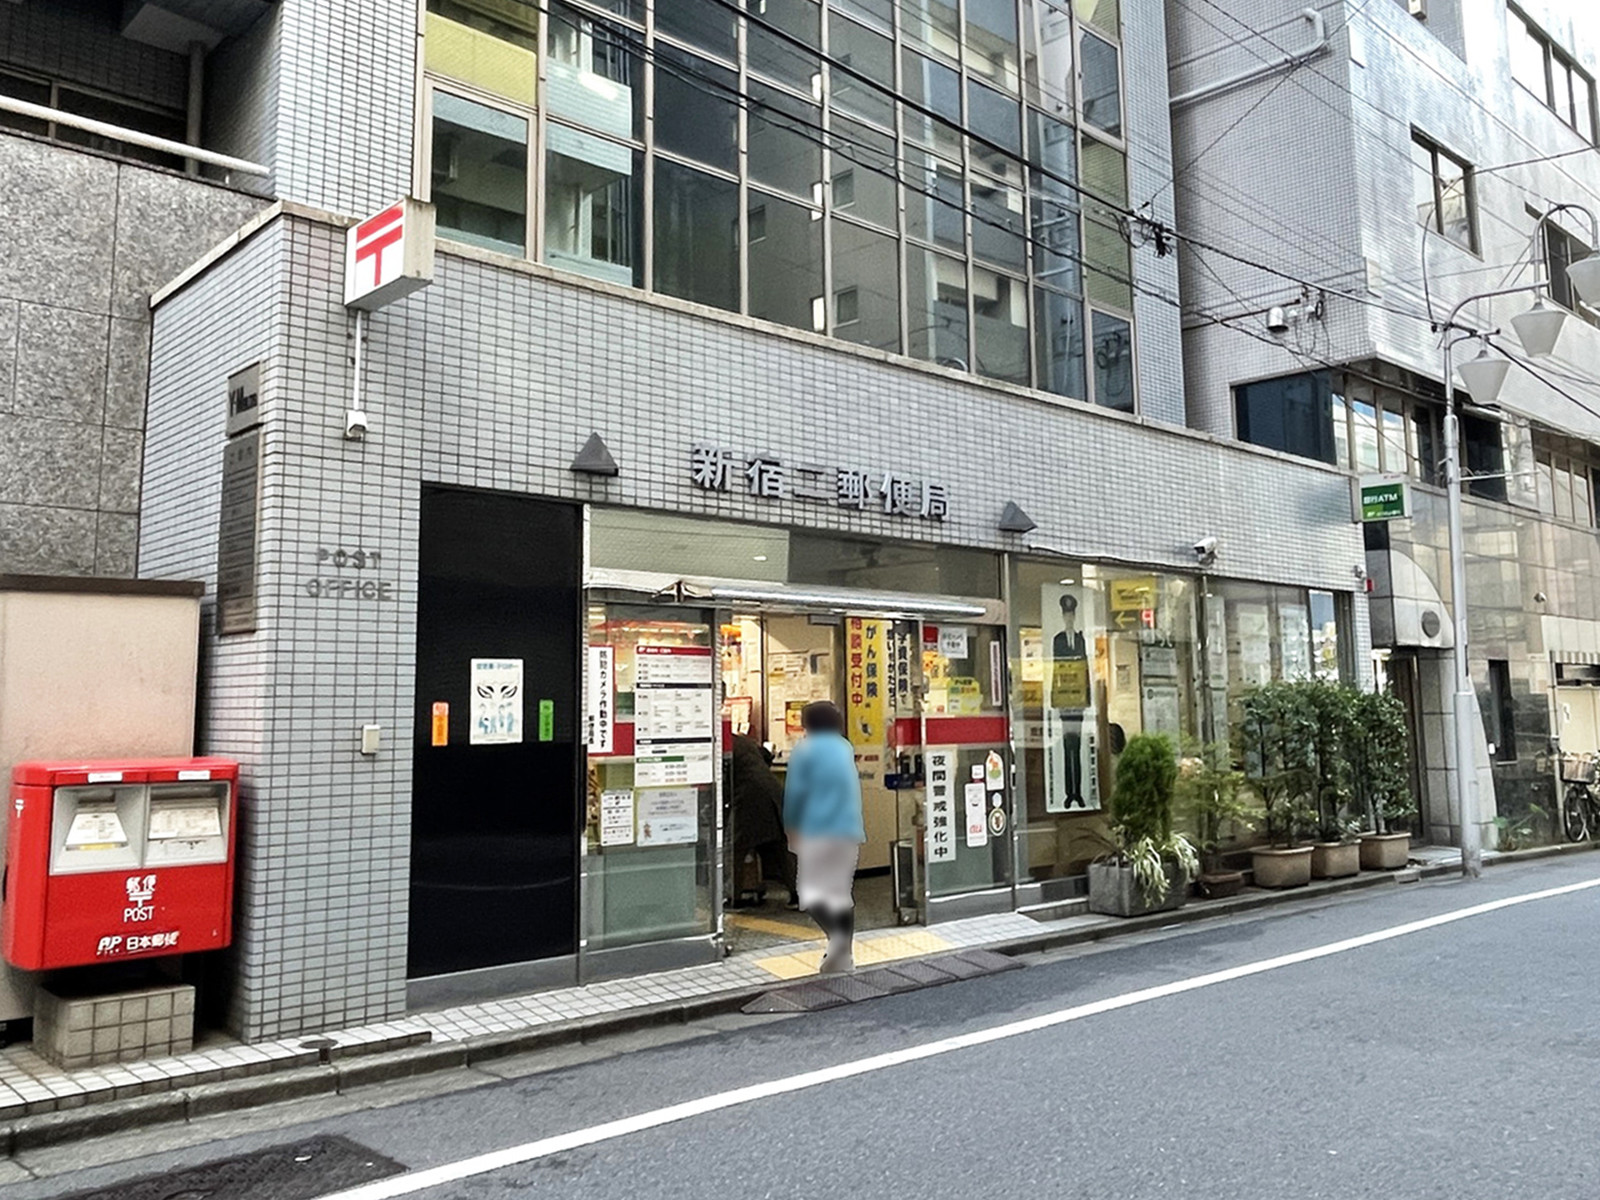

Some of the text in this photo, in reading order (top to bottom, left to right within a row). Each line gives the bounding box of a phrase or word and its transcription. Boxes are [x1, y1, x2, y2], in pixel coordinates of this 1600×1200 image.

[692, 443, 950, 520] 新宿二郵便局
[318, 548, 381, 569] POST
[306, 578, 391, 600] OFFICE
[866, 624, 878, 698] がん保険
[932, 755, 948, 858] 夜間警戒強化中
[126, 874, 157, 894] 郵便
[124, 905, 155, 923] POST
[126, 931, 180, 951] 日本郵便
